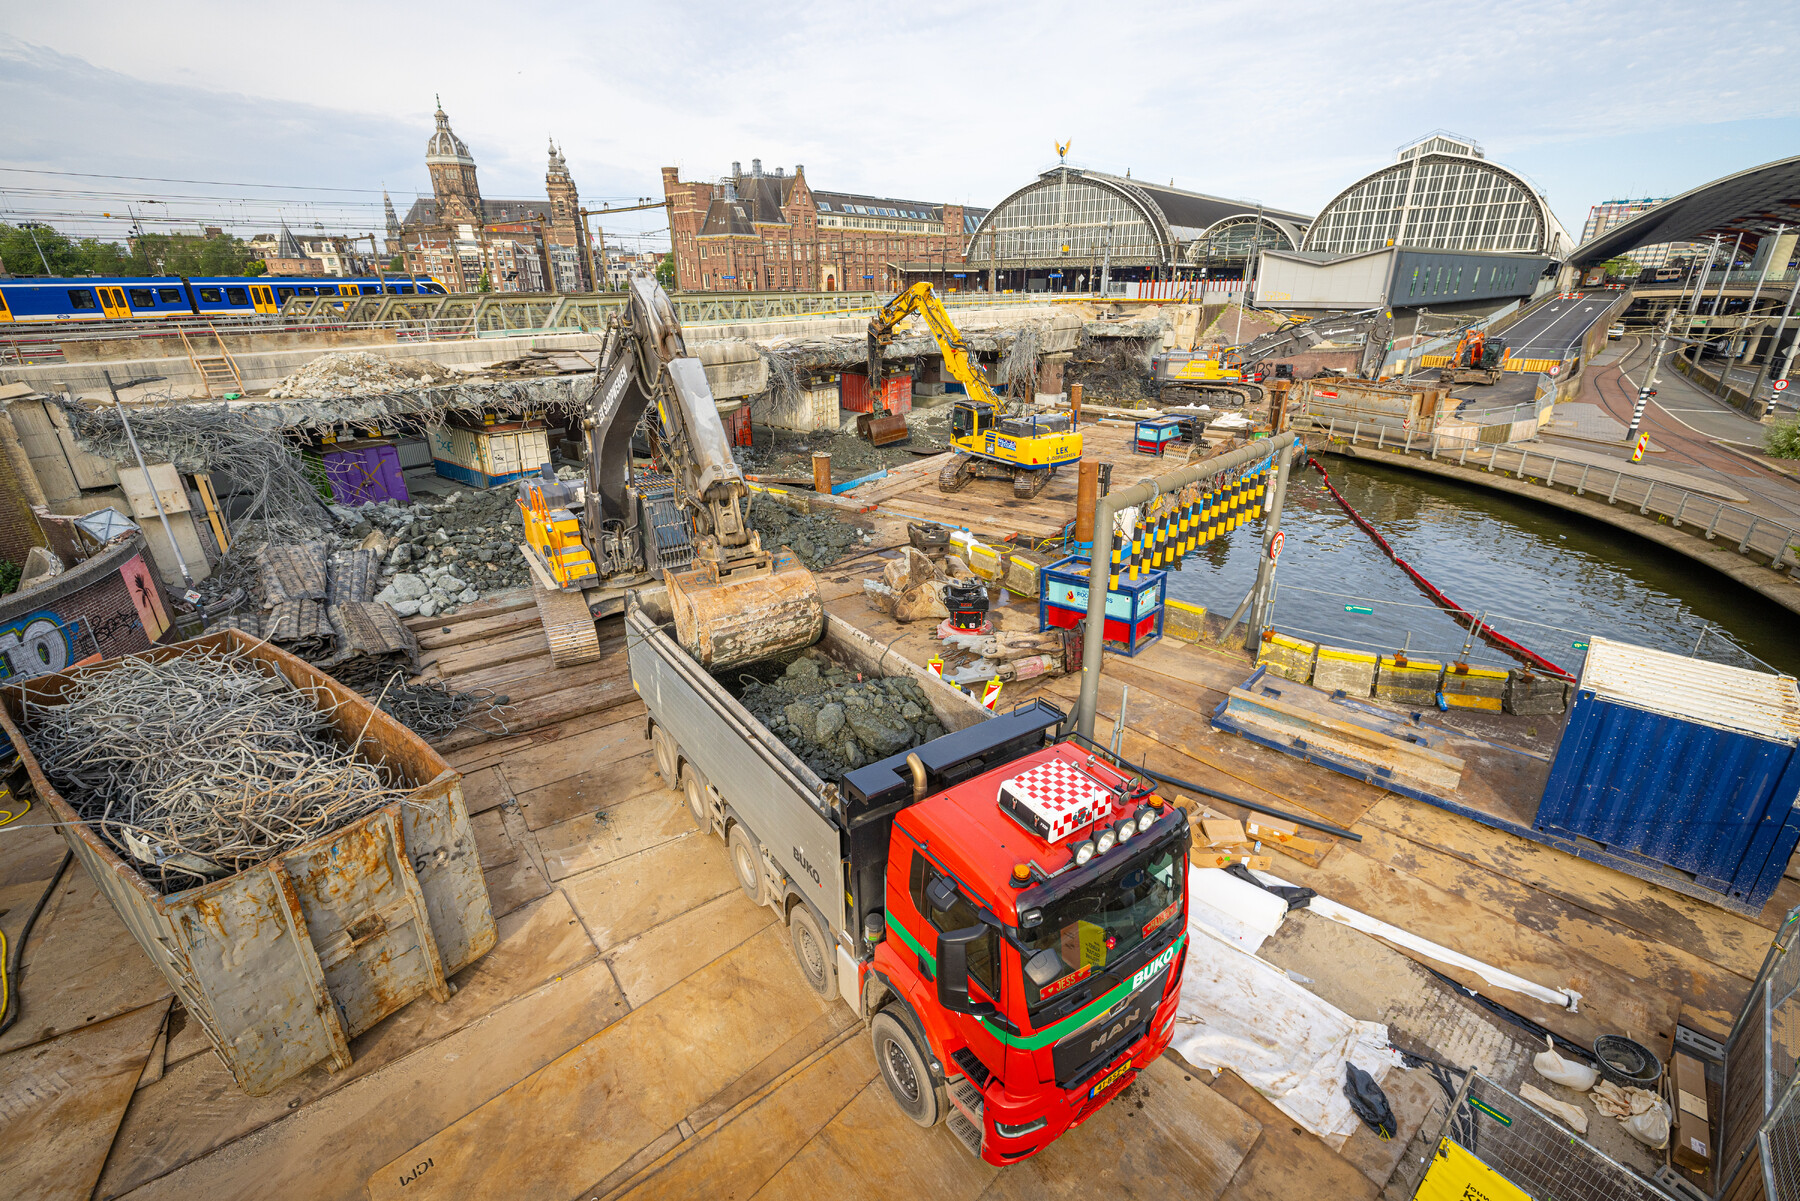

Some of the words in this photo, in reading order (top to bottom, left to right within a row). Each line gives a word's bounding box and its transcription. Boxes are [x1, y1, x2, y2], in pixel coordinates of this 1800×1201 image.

[1046, 452, 1077, 462] SOOPWERKEN
[1055, 446, 1069, 455] LEK
[1056, 974, 1076, 992] JESS
[1090, 1008, 1140, 1053] MAN
